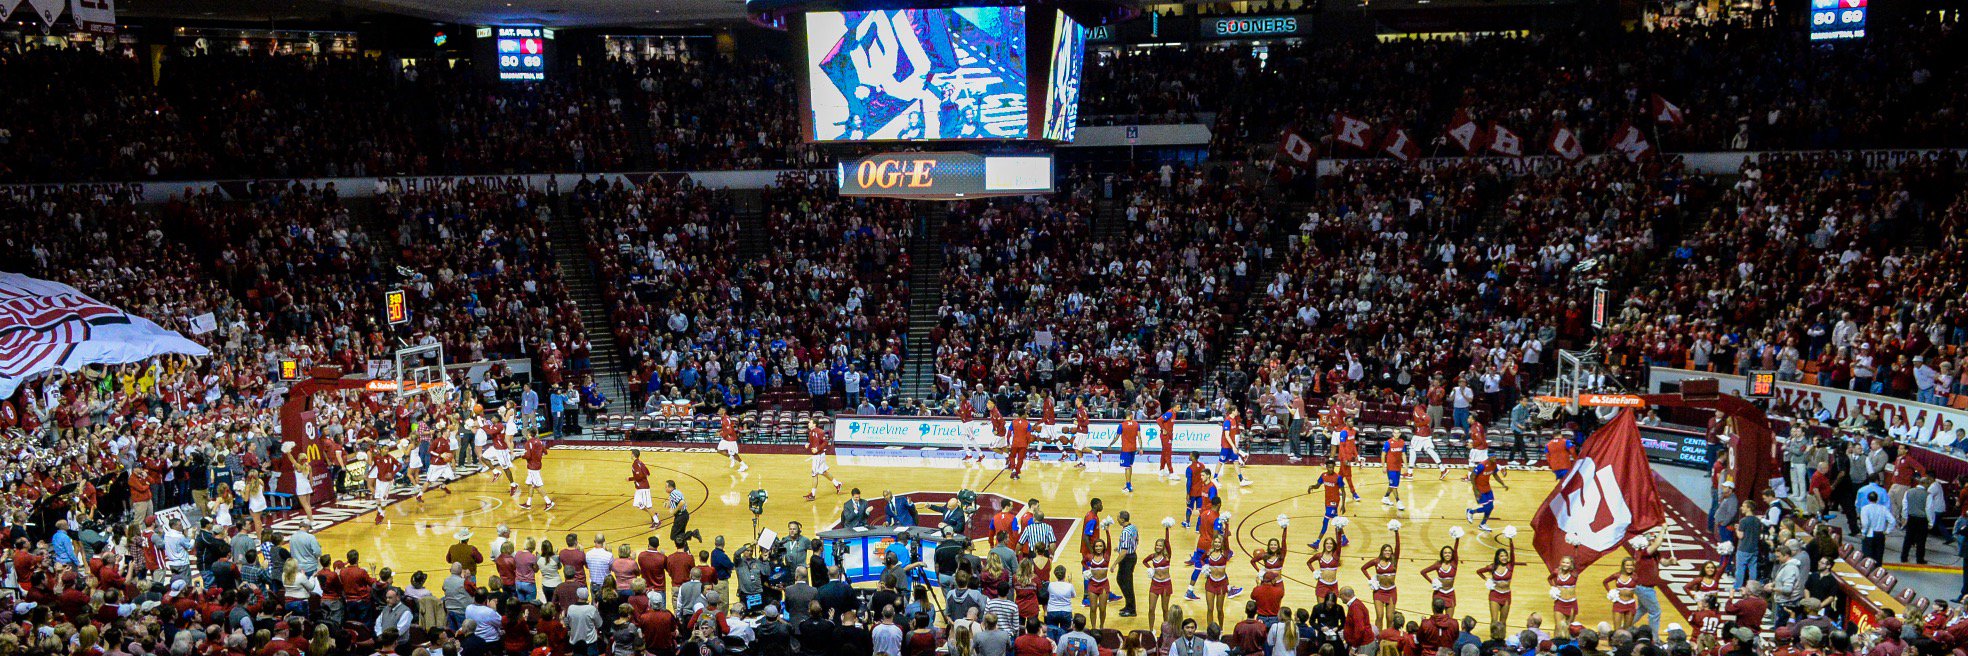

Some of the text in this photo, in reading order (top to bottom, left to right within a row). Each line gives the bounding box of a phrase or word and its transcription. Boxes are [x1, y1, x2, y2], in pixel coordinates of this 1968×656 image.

[1216, 18, 1297, 35] SOONERS
[1813, 11, 1836, 25] 80
[501, 56, 519, 67] 80
[1337, 115, 1370, 148] K
[1449, 120, 1476, 151] A
[1490, 124, 1521, 156] H
[1386, 129, 1409, 161] L
[1554, 127, 1585, 161] O
[1615, 125, 1650, 162] M
[1756, 374, 1773, 383] 3:03
[1754, 383, 1770, 394] 30
[862, 423, 909, 435] TrueVine
[933, 424, 980, 437] TrueVe
[1702, 616, 1719, 633] 10
